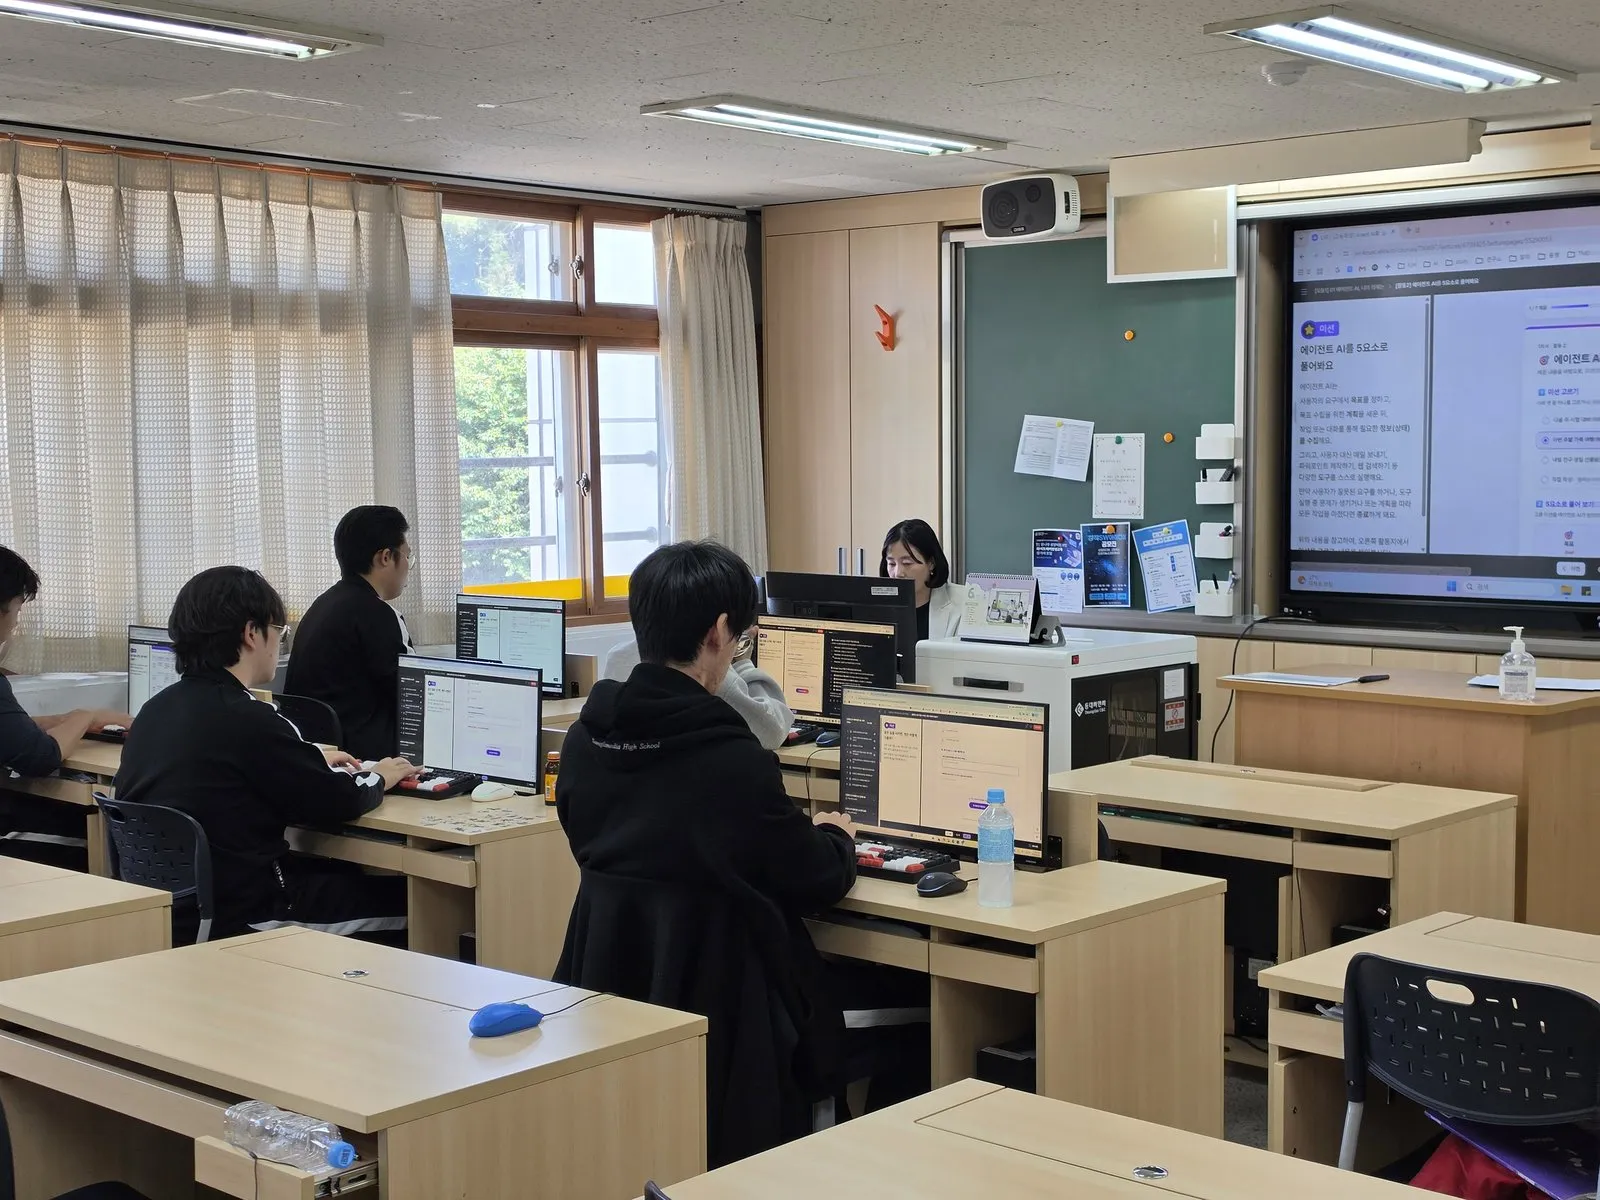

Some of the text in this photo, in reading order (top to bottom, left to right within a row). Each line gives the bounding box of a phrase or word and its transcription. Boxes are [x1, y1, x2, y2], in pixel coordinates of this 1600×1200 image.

[1320, 324, 1335, 334] 미션
[1300, 342, 1389, 356] 에이전트 AI를 5요소로
[1553, 353, 1591, 365] 에이전트
[1300, 361, 1334, 372] 풀어봐요
[968, 588, 975, 598] 6
[622, 743, 638, 751] High
[639, 741, 661, 750] School
